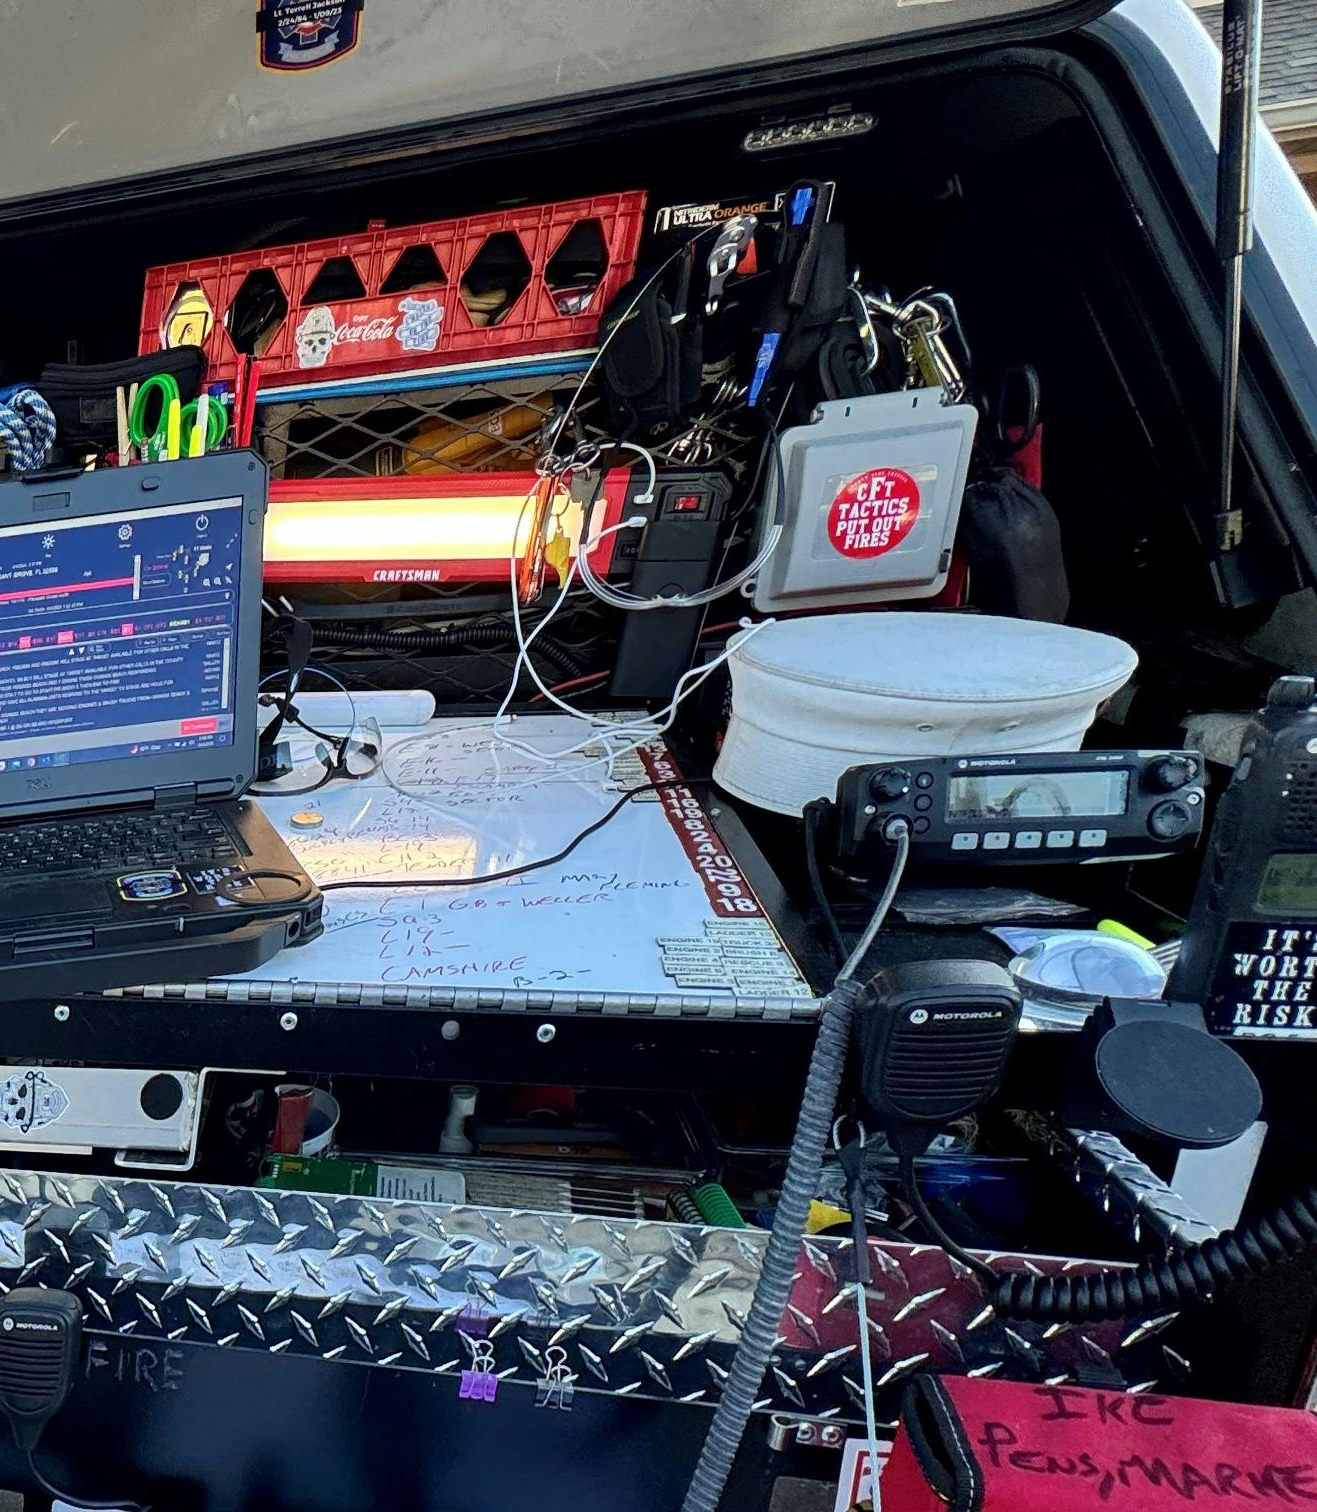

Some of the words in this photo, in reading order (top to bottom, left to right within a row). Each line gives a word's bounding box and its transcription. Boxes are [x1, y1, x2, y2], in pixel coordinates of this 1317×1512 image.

[673, 212, 713, 226] ULTRA
[714, 202, 769, 219] ORANGE
[838, 497, 910, 520] TACTICS
[835, 519, 870, 537] PUT
[871, 515, 904, 533] OUT
[844, 531, 891, 550] FIRES
[372, 567, 441, 583] CRAFTSMAN
[969, 758, 1016, 767] MOTOROLA
[717, 884, 742, 897] 9
[717, 898, 758, 912] 18
[666, 966, 712, 974] ENGINE
[731, 968, 781, 976] ENGINE
[1234, 953, 1317, 979] WORT
[678, 977, 722, 985] ENGINE
[739, 979, 787, 987] ENGINE
[738, 988, 791, 997] LADDER
[1252, 979, 1313, 1002] THE
[932, 1010, 1003, 1020] MOTOROLA
[1233, 1002, 1317, 1027] RISK
[16, 1321, 59, 1332] MOTOROLA
[85, 1338, 184, 1392] FIRE
[1116, 1455, 1317, 1501] MARKE
